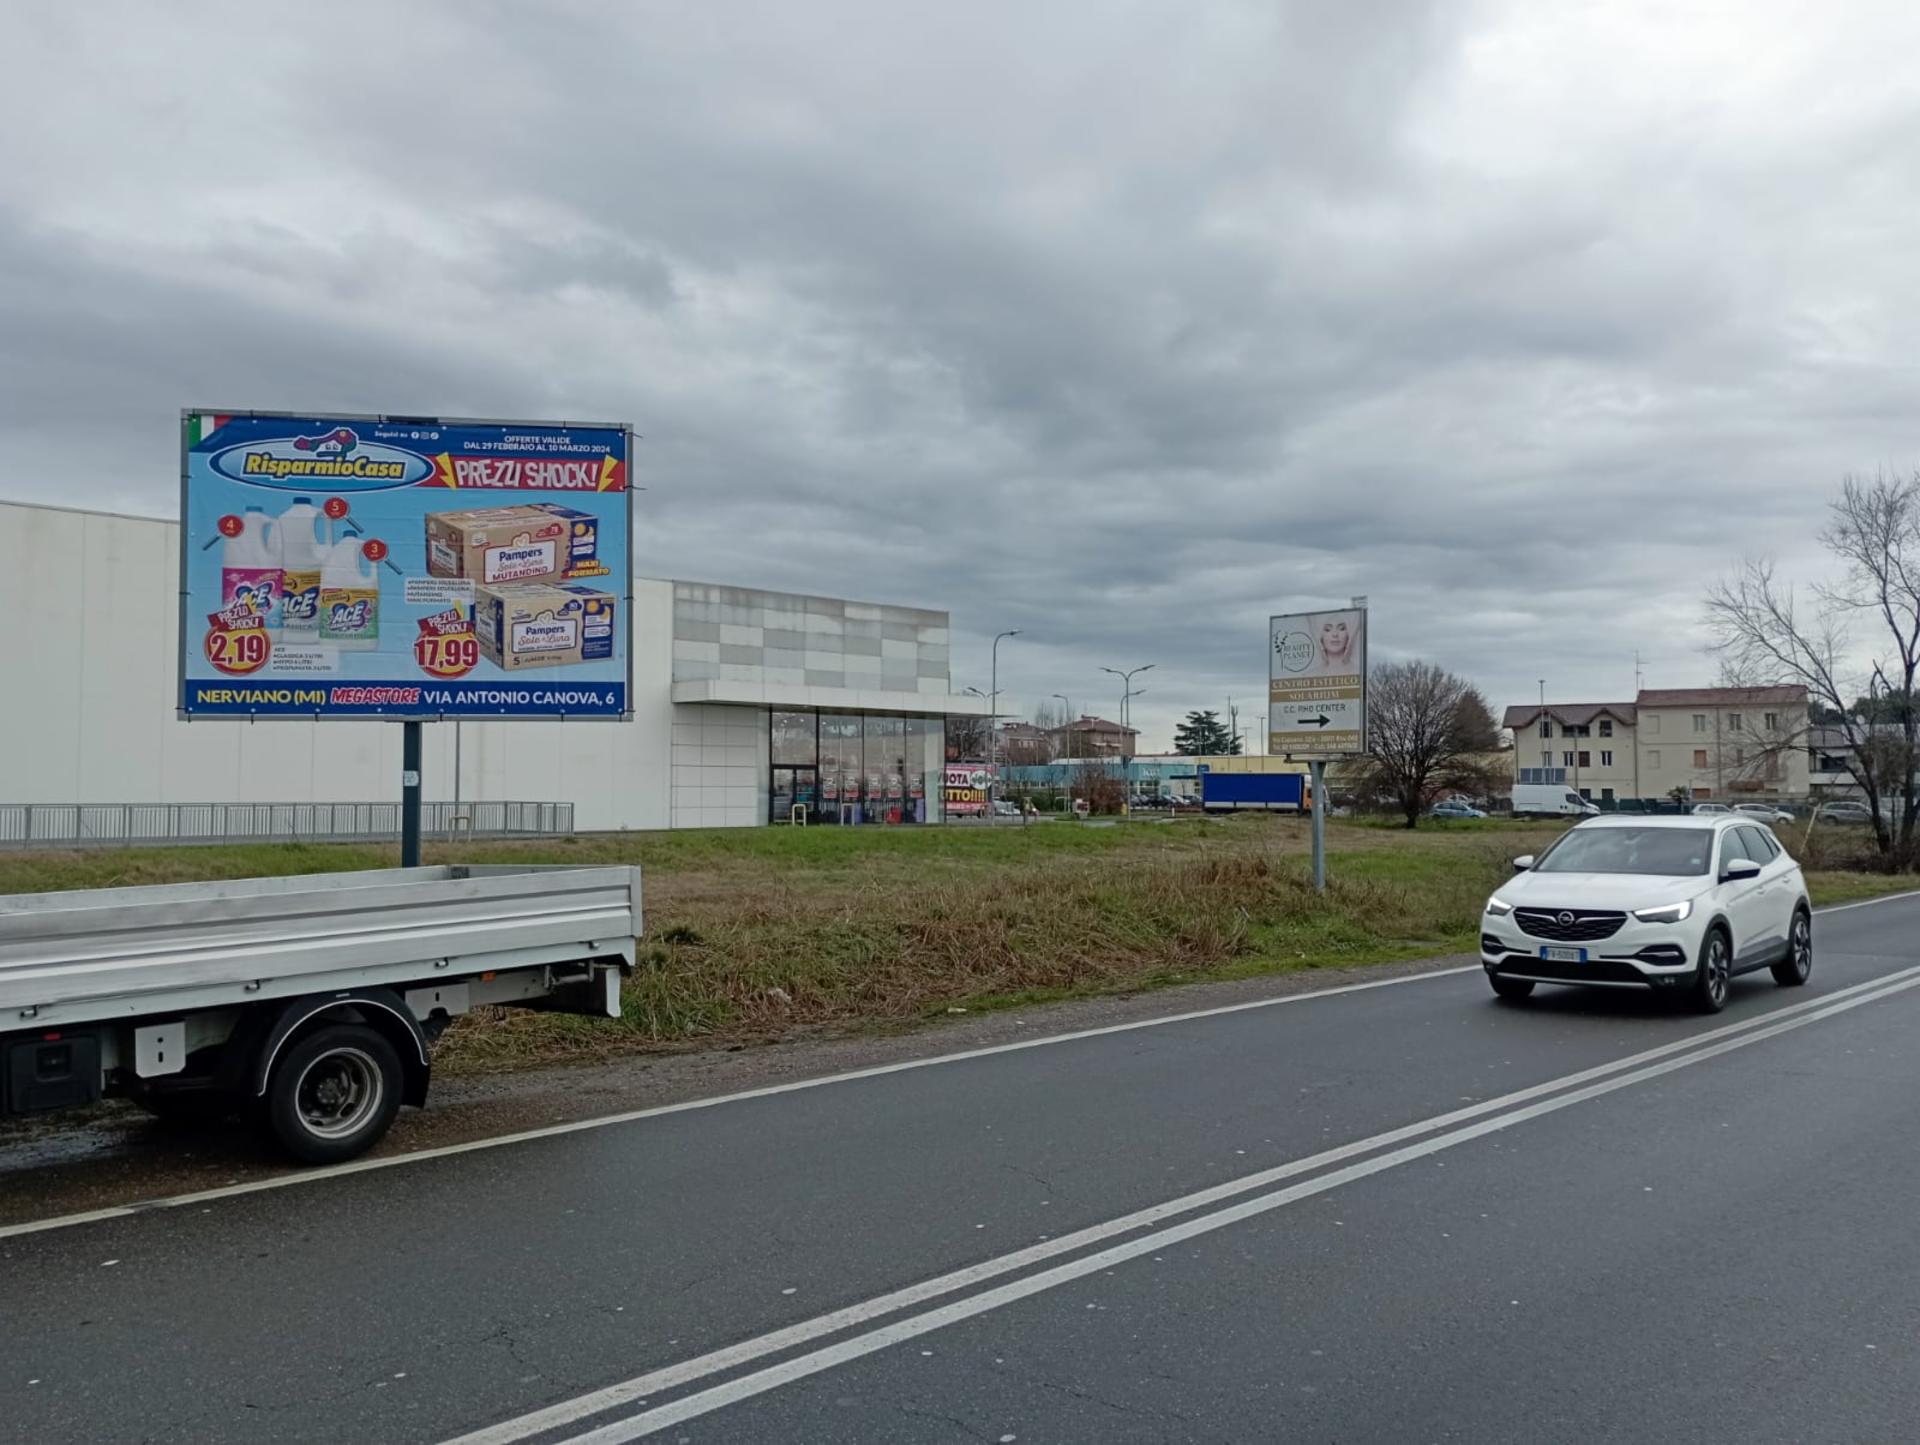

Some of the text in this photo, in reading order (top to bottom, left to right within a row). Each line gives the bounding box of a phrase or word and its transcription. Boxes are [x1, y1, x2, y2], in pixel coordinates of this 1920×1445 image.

[504, 435, 570, 444] OFFERTE VALIDE
[464, 441, 480, 449] DAL
[493, 442, 534, 450] FEBBRAIO
[534, 443, 546, 451] AL
[548, 443, 557, 451] 10
[559, 444, 590, 452] MARZO
[591, 445, 610, 453] 2024
[244, 453, 404, 478] RisparmioCasa
[455, 459, 599, 488] PREZZI SHOCK!
[332, 502, 339, 511] 5
[227, 521, 234, 529] 4
[371, 544, 378, 553] 3
[499, 548, 543, 562] Pampers
[492, 566, 549, 581] MUTANDINO
[332, 604, 364, 624] ACE
[428, 610, 457, 627] PREZZO
[526, 626, 565, 636] Pampers
[210, 634, 265, 664] 2,19
[414, 639, 479, 668] 17,99
[513, 656, 520, 665] 5
[1272, 676, 1358, 689] CENTRO ESTETICO
[197, 687, 615, 706] NERVIANO (MI) MEGASTORE VIA ANTONIO CANOVA, 6
[1289, 690, 1340, 700] SOLARIUM
[1316, 703, 1346, 712] CENTER
